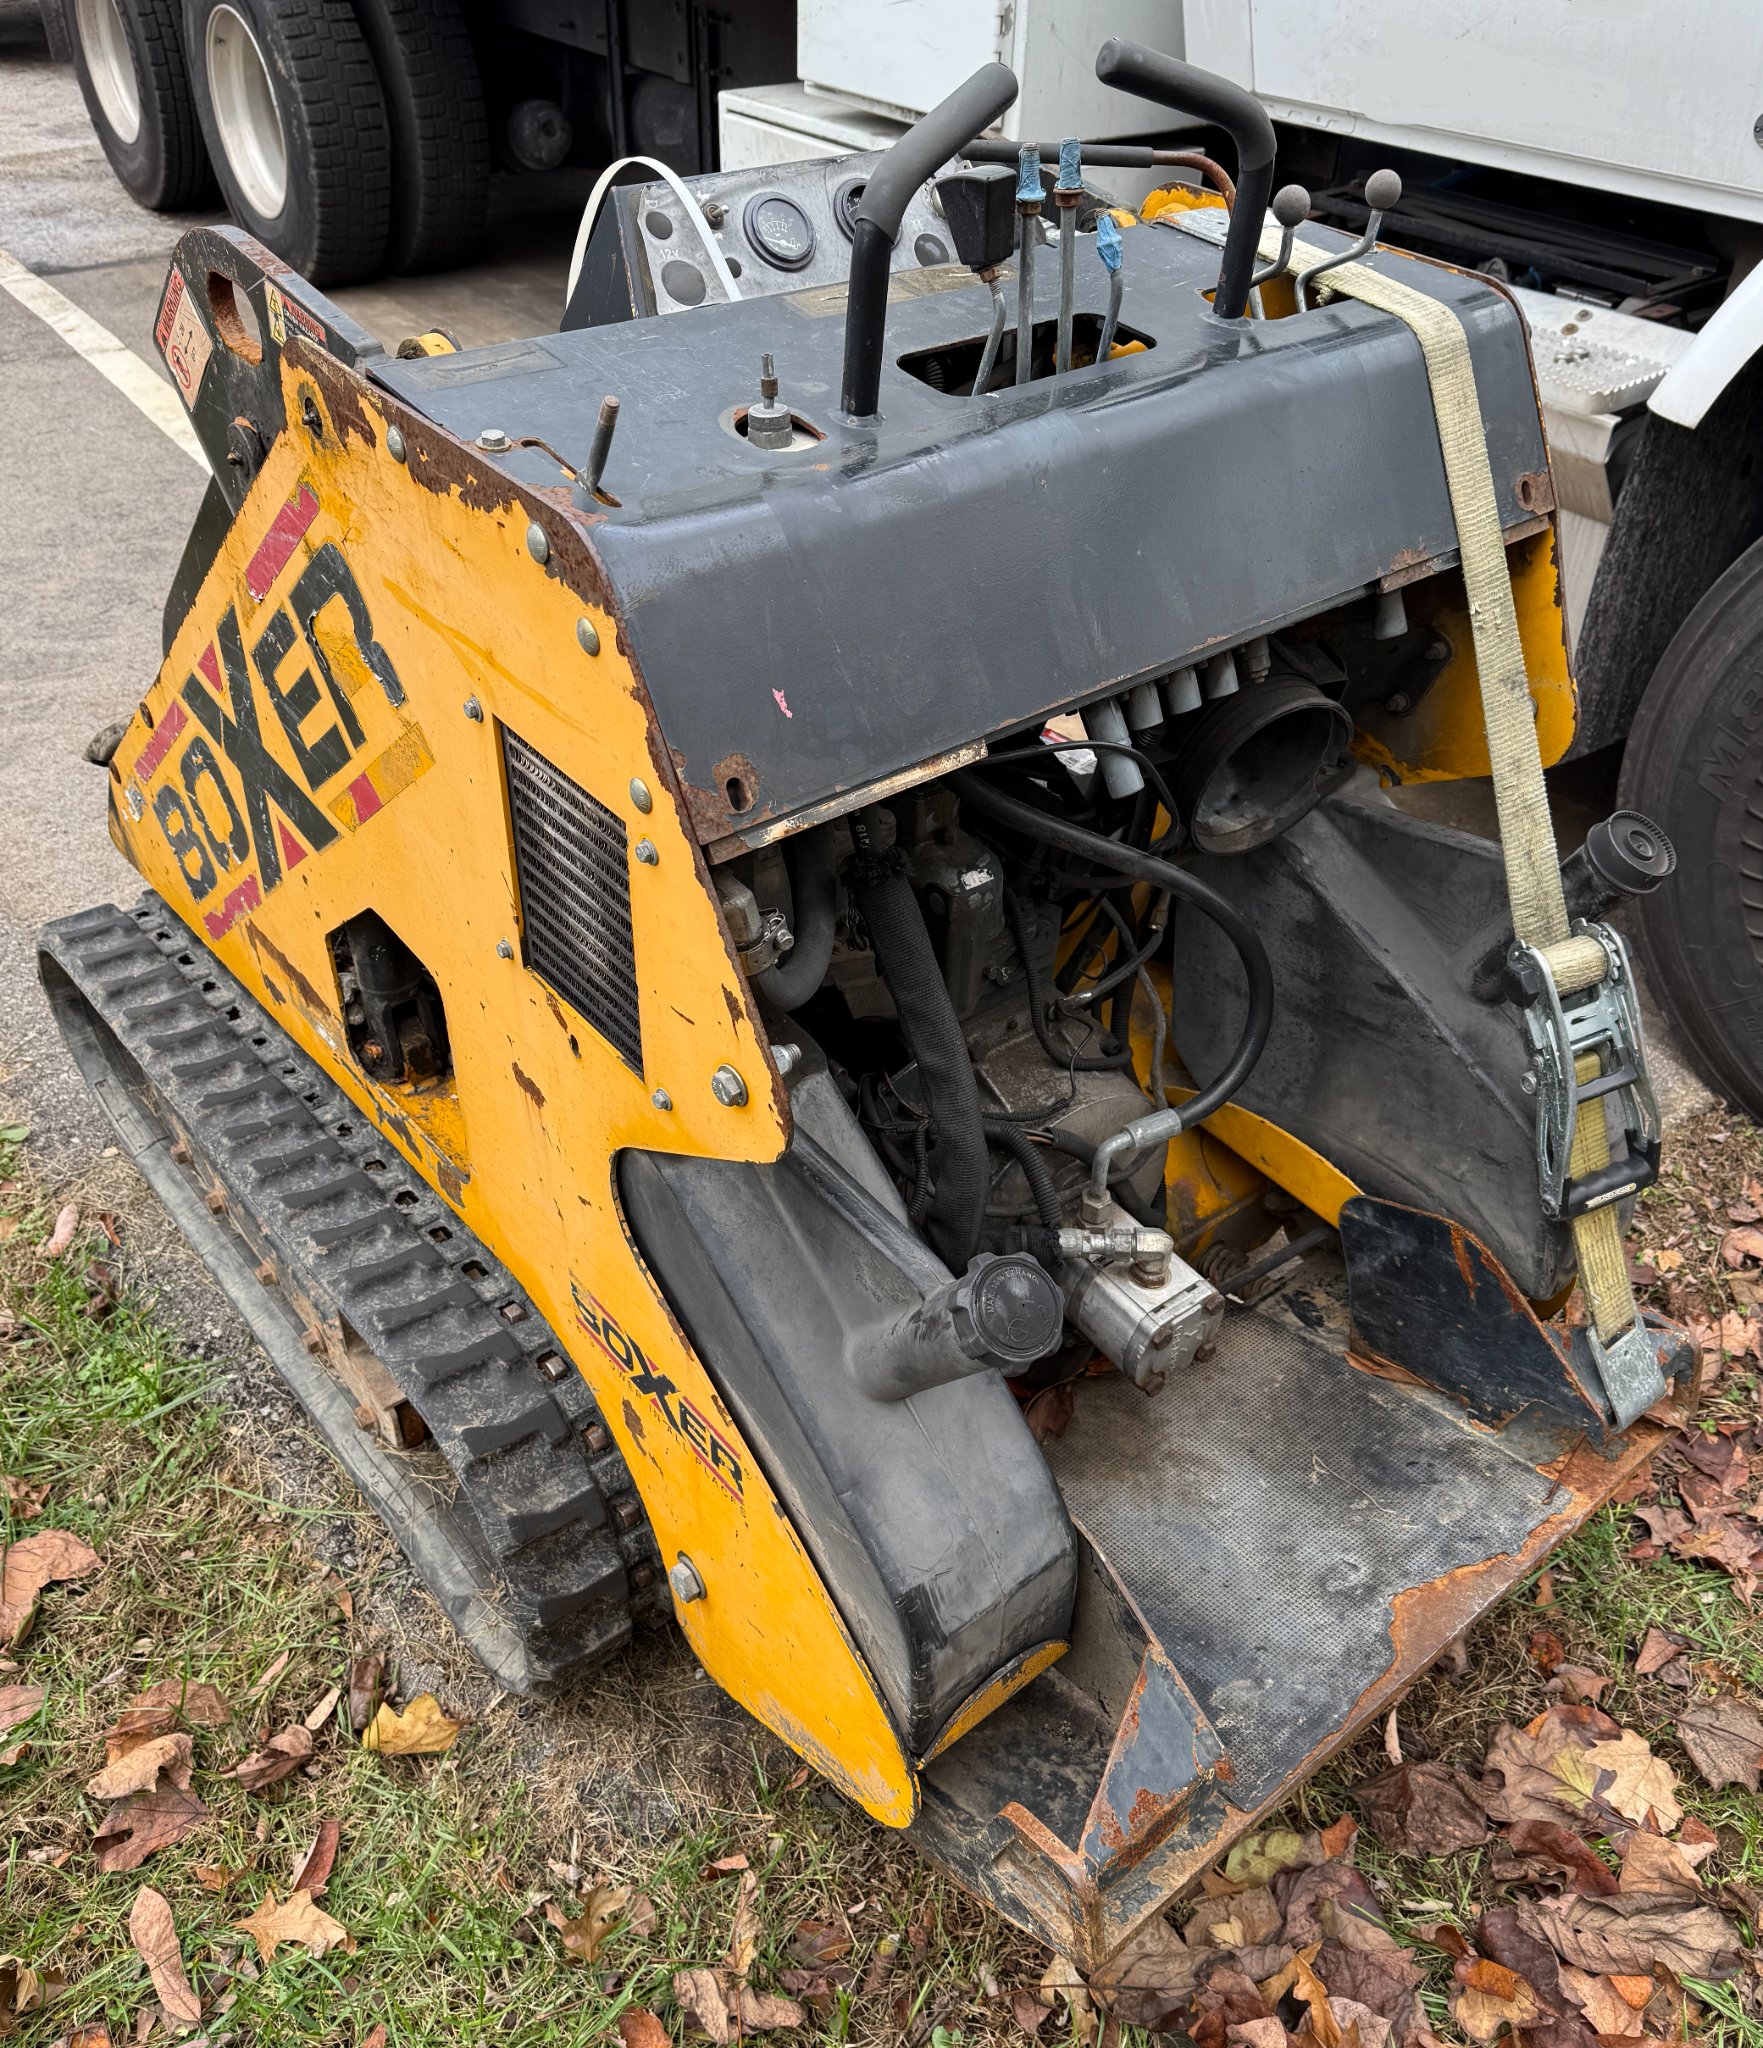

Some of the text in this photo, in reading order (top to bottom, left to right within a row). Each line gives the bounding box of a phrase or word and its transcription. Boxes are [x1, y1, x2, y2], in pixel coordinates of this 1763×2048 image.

[162, 275, 183, 333] WARNING
[291, 305, 321, 336] WARNING
[152, 541, 408, 904] BOXER
[570, 1279, 745, 1497] BOXER
